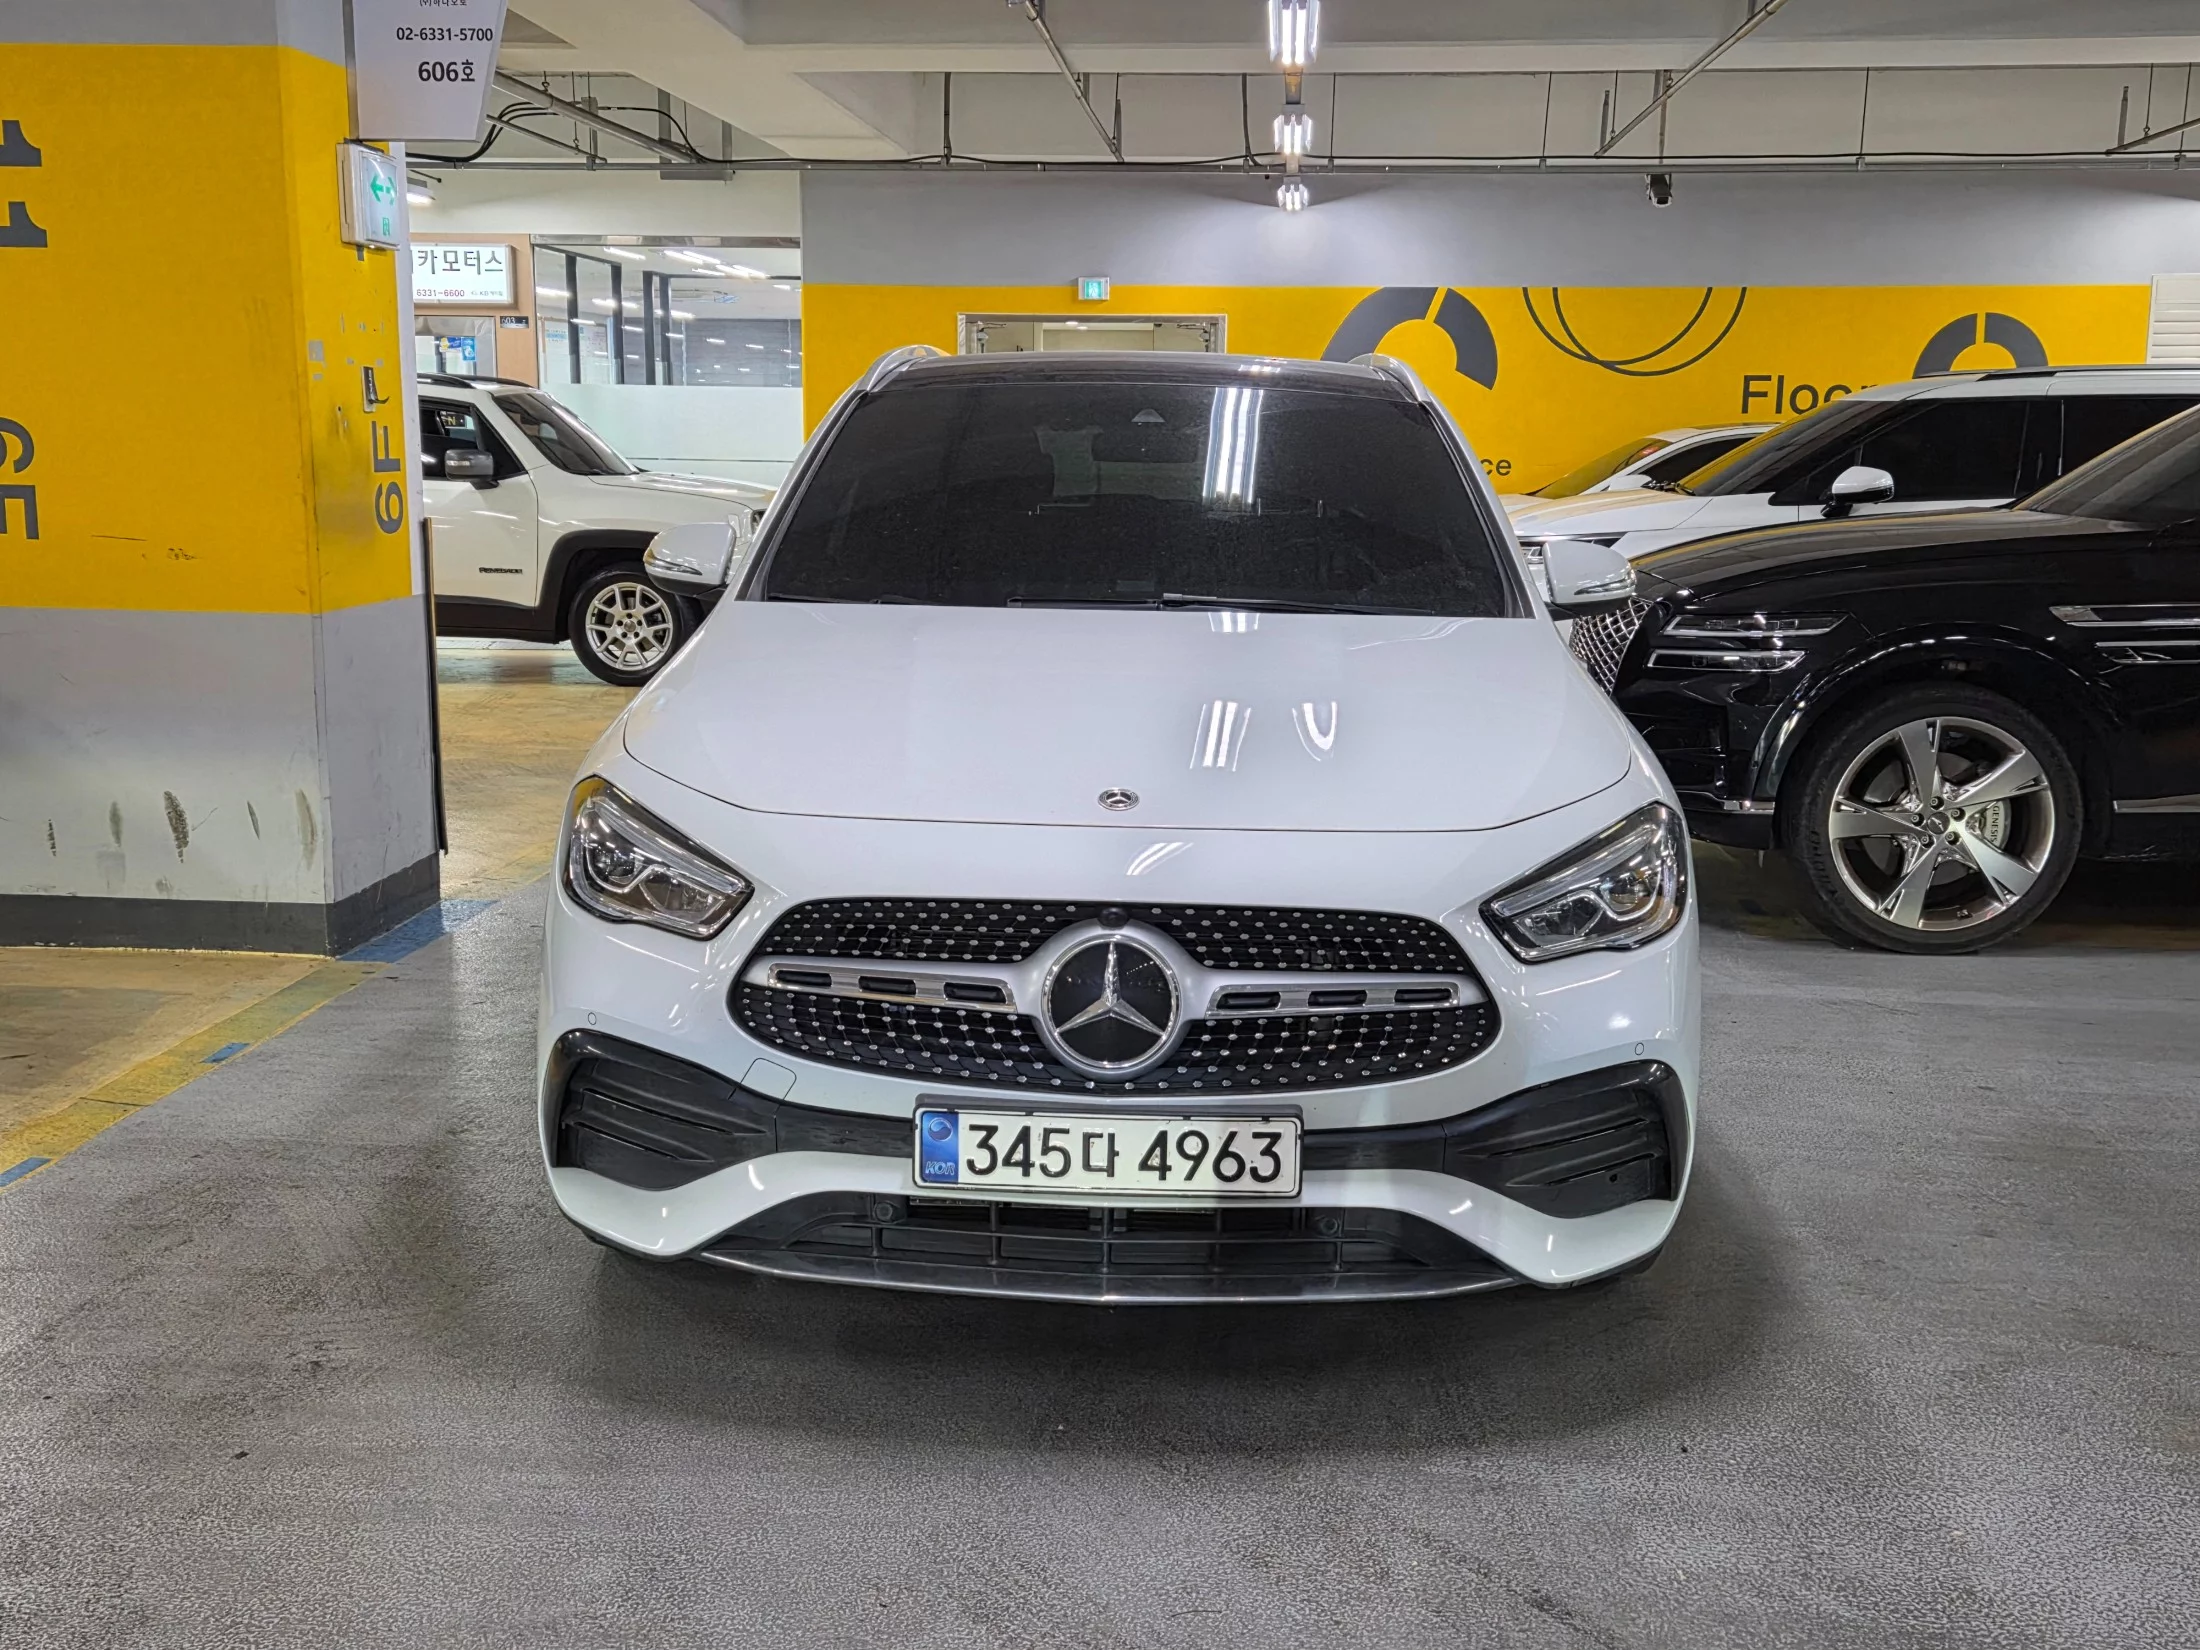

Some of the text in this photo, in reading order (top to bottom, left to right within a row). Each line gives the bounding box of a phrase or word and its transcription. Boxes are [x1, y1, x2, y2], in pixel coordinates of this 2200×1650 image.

[396, 27, 493, 41] 02-6331-5700
[418, 59, 476, 82] 606호
[411, 249, 504, 275] 카모터스
[1741, 374, 1878, 415] Flo
[371, 420, 404, 535] 6F
[1990, 805, 2000, 843] GENESIS
[925, 1160, 956, 1176] KOR
[966, 1123, 1283, 1184] 345다 4963
